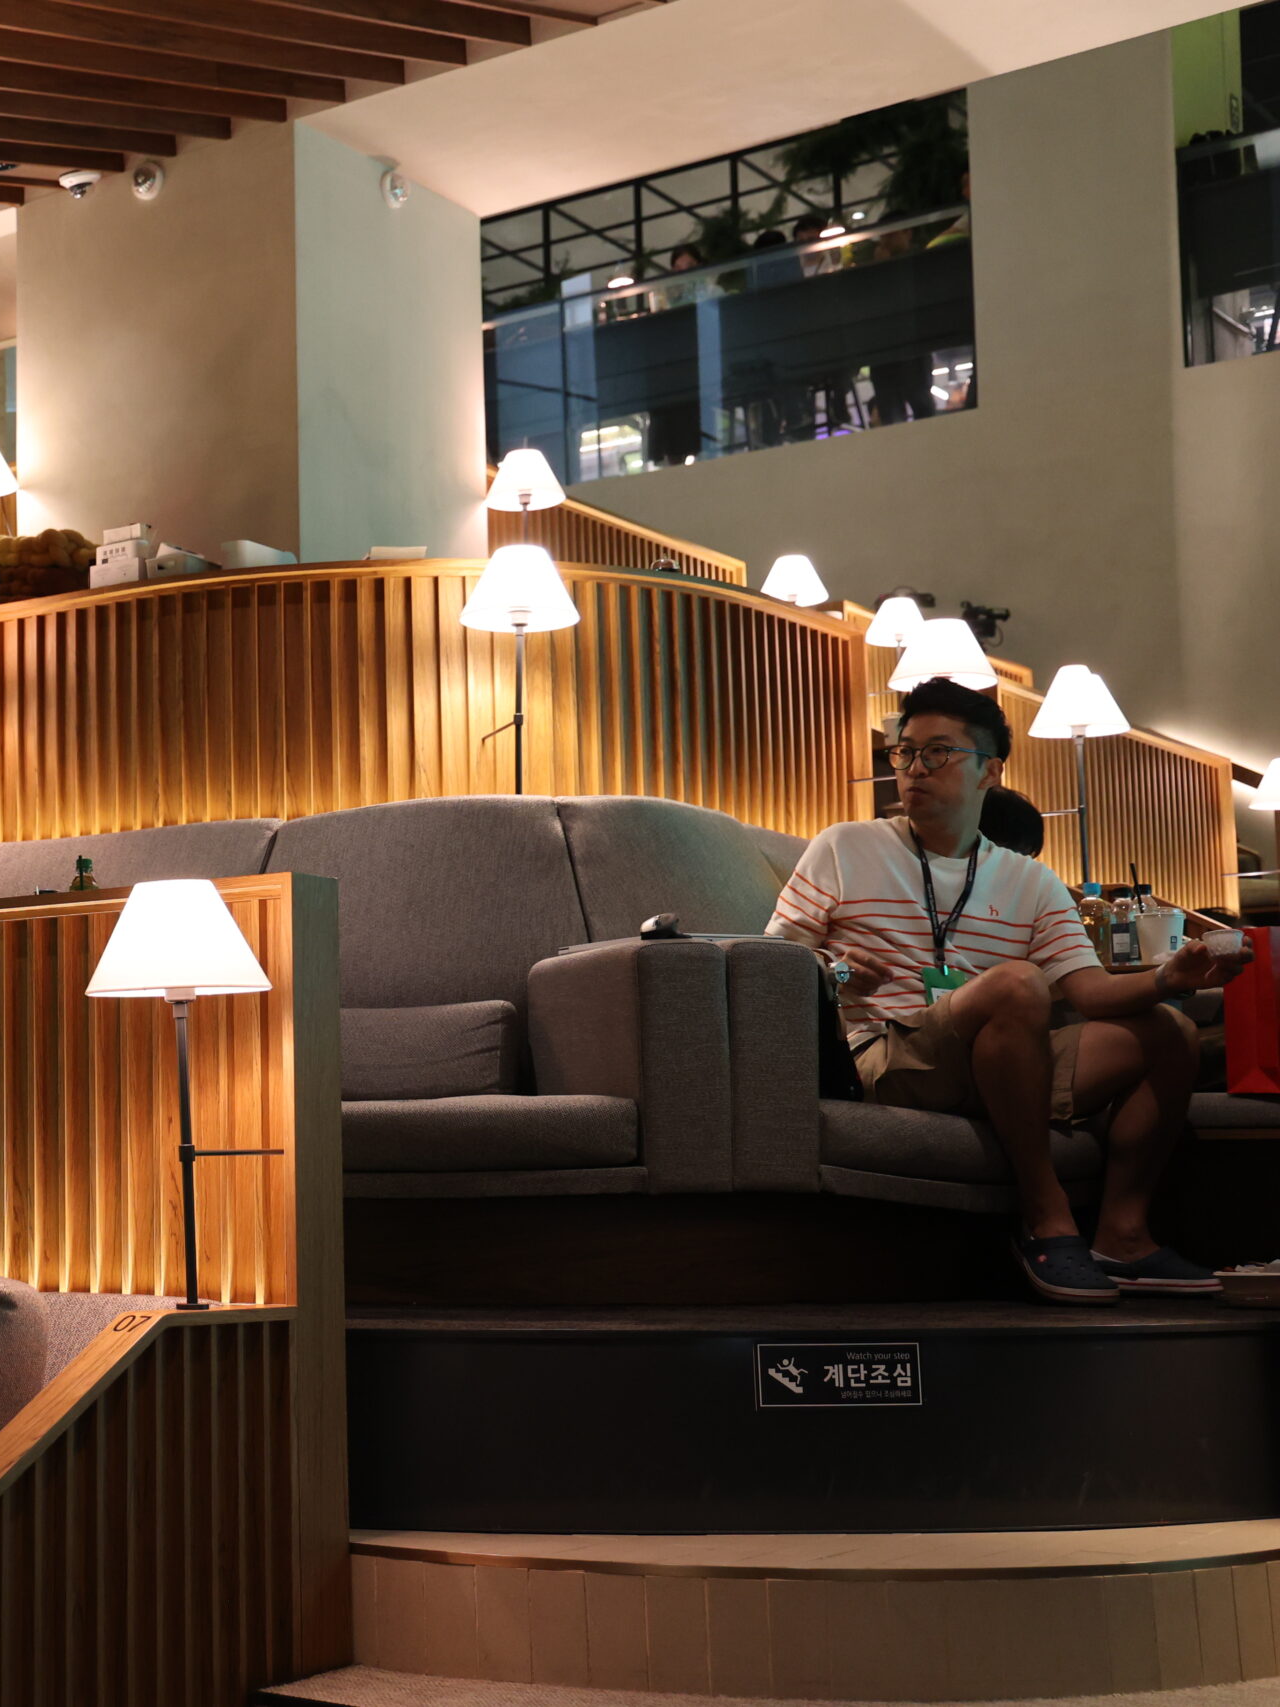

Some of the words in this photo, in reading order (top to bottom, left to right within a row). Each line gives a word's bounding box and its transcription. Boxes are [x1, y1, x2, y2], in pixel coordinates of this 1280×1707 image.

[113, 1314, 152, 1333] 07
[846, 1351, 872, 1360] Watch
[873, 1352, 891, 1361] your
[893, 1351, 910, 1361] step
[823, 1362, 912, 1388] 계단조심
